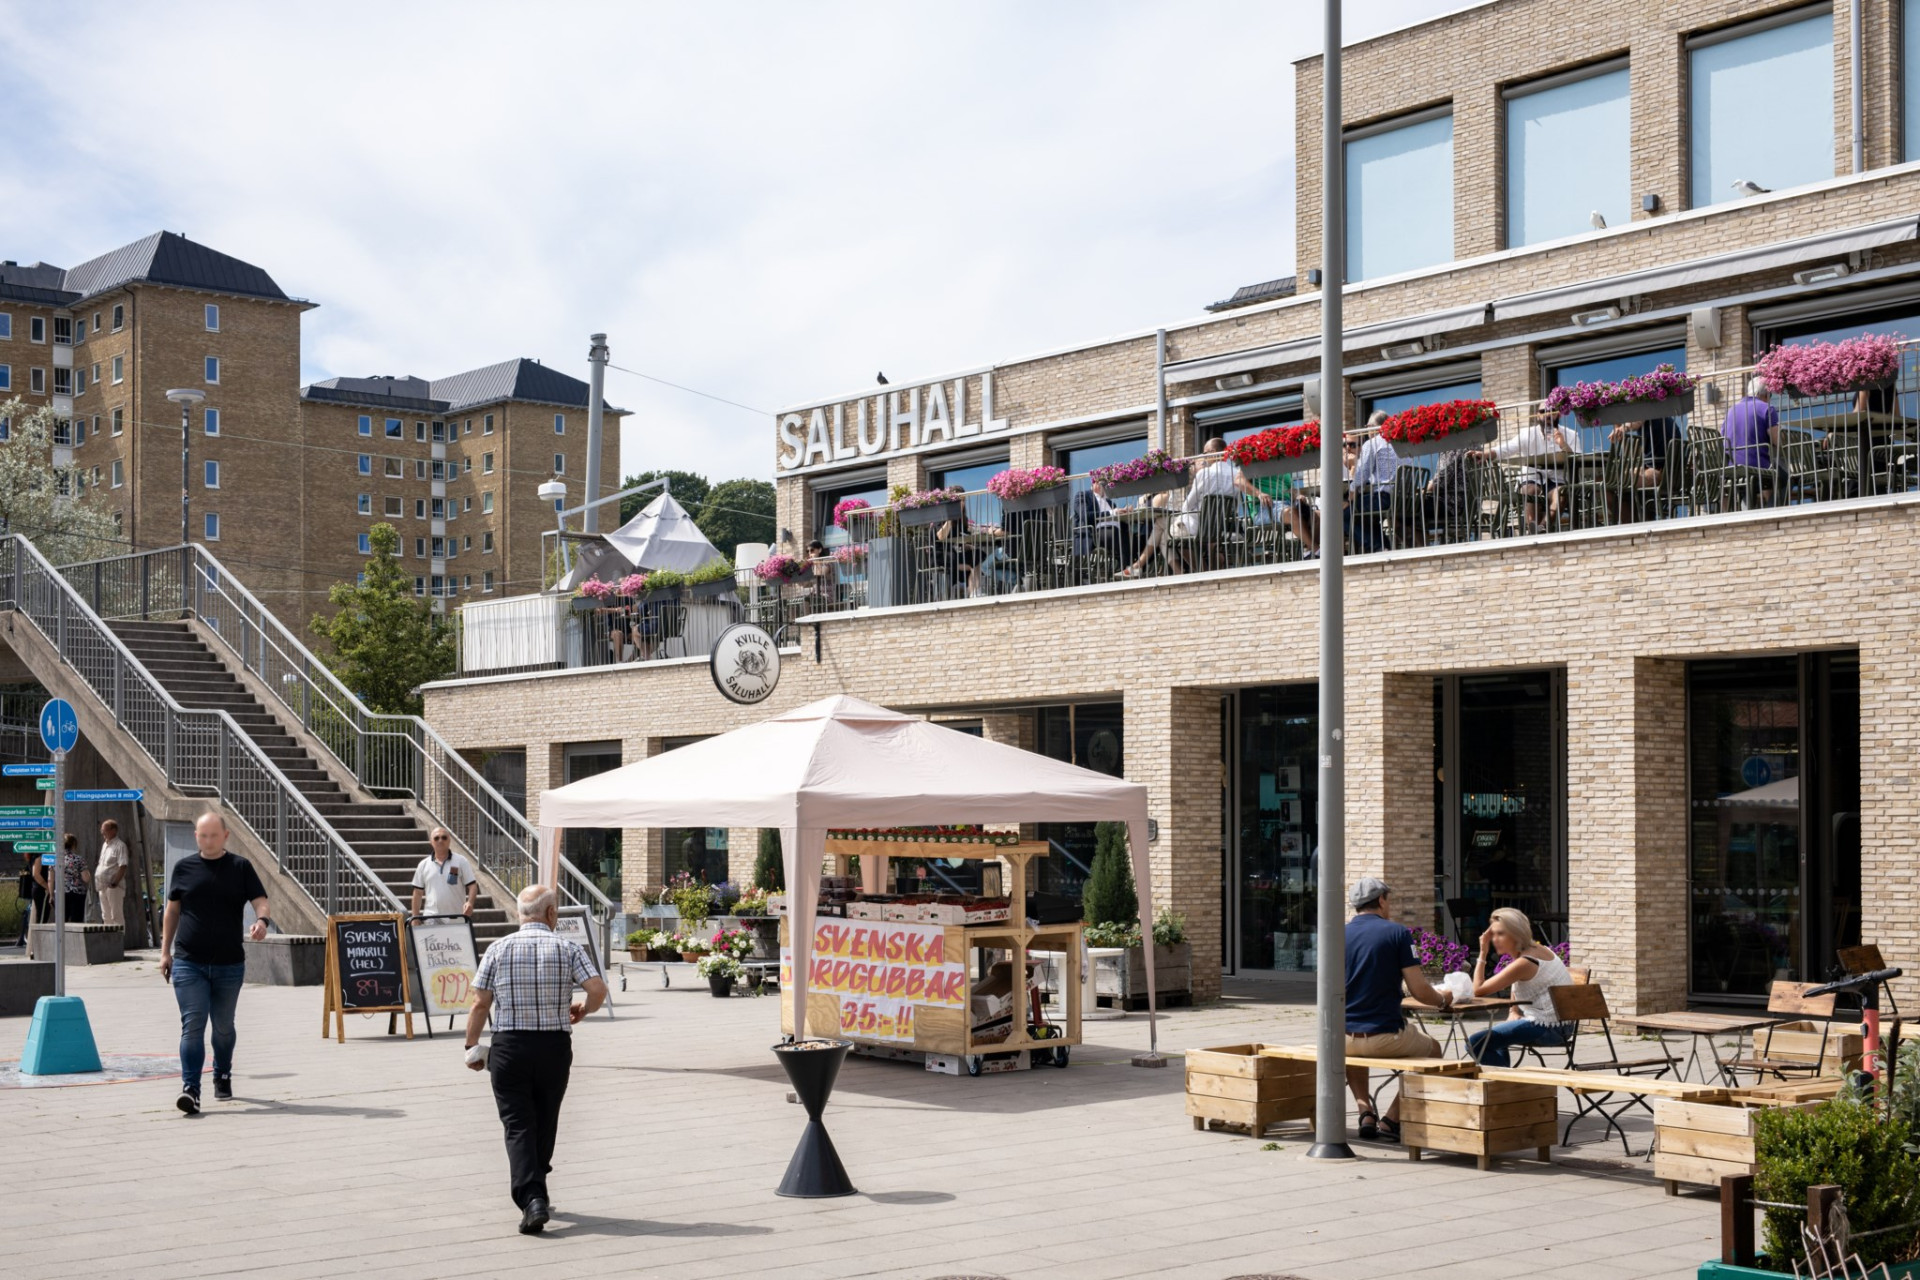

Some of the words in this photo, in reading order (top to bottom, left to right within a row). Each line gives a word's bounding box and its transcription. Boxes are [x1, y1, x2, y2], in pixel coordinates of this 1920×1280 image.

[779, 371, 1009, 470] SALUHALL
[735, 634, 770, 651] KVILLE
[725, 675, 771, 699] SALUHALL
[76, 792, 116, 800] Hisingsparken
[344, 931, 391, 944] SVENSK
[815, 924, 944, 964] SVENSKA
[347, 946, 388, 958] MAKRILL
[350, 958, 384, 970] (HEL)
[780, 955, 965, 1001] JRDGUBBAR
